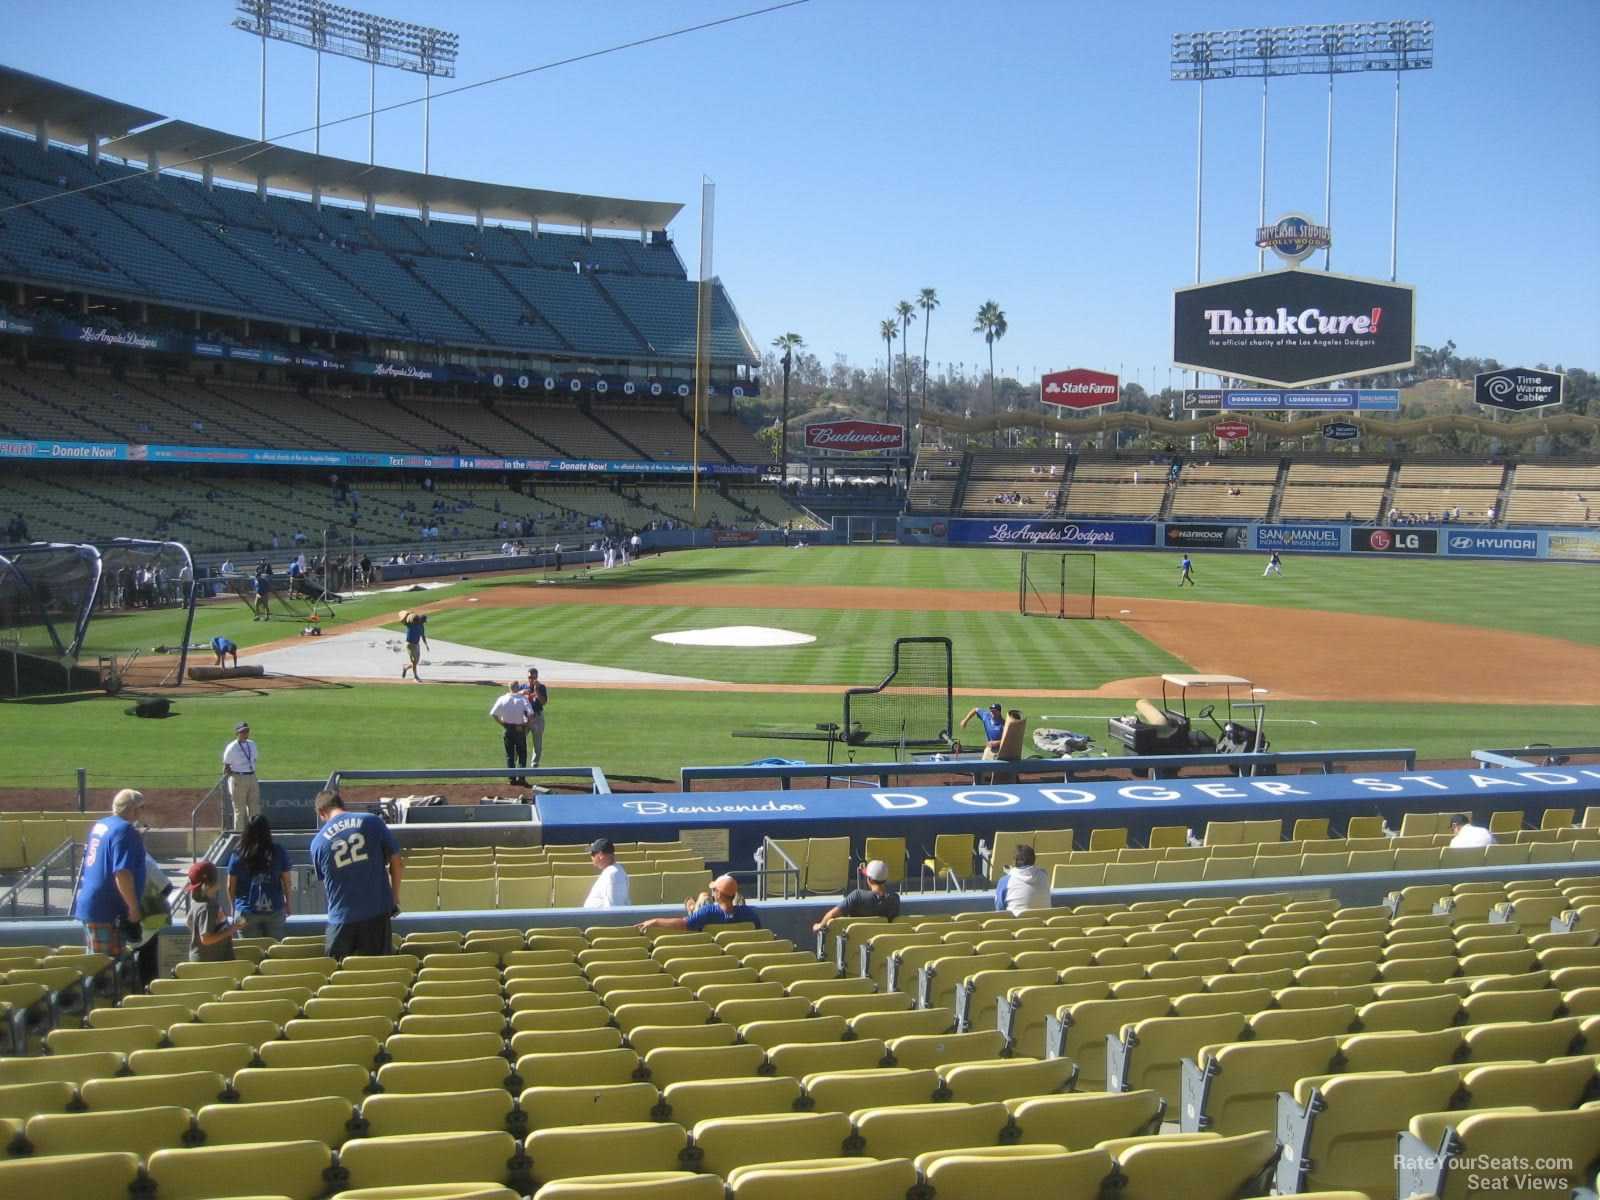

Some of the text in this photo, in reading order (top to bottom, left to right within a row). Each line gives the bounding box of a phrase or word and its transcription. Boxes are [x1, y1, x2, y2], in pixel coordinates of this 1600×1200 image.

[1256, 225, 1330, 240] UNIVERSAL STUDIOS
[1204, 307, 1381, 334] ThinkCure!
[80, 327, 157, 349] Los Angeles Dodgers
[1250, 339, 1274, 347] charity
[1313, 339, 1342, 347] Angeles
[1344, 339, 1375, 347] Dodgers
[1517, 376, 1542, 384] Time
[810, 428, 900, 444] Budweiser
[52, 444, 90, 456] Donate
[92, 447, 116, 458] Now!
[390, 457, 403, 466] Text
[460, 460, 468, 468] Be
[513, 460, 525, 468] the
[560, 462, 586, 470] Donate
[989, 524, 1114, 544] Los Angeles Dodgers
[1260, 529, 1338, 540] SAN MANUEL
[1396, 535, 1418, 549] LG
[1476, 538, 1536, 549] HYUNDAI
[871, 781, 1311, 809] DODGER
[622, 800, 807, 815] Bienvenidos
[86, 838, 100, 868] 5
[331, 832, 368, 868] 22
